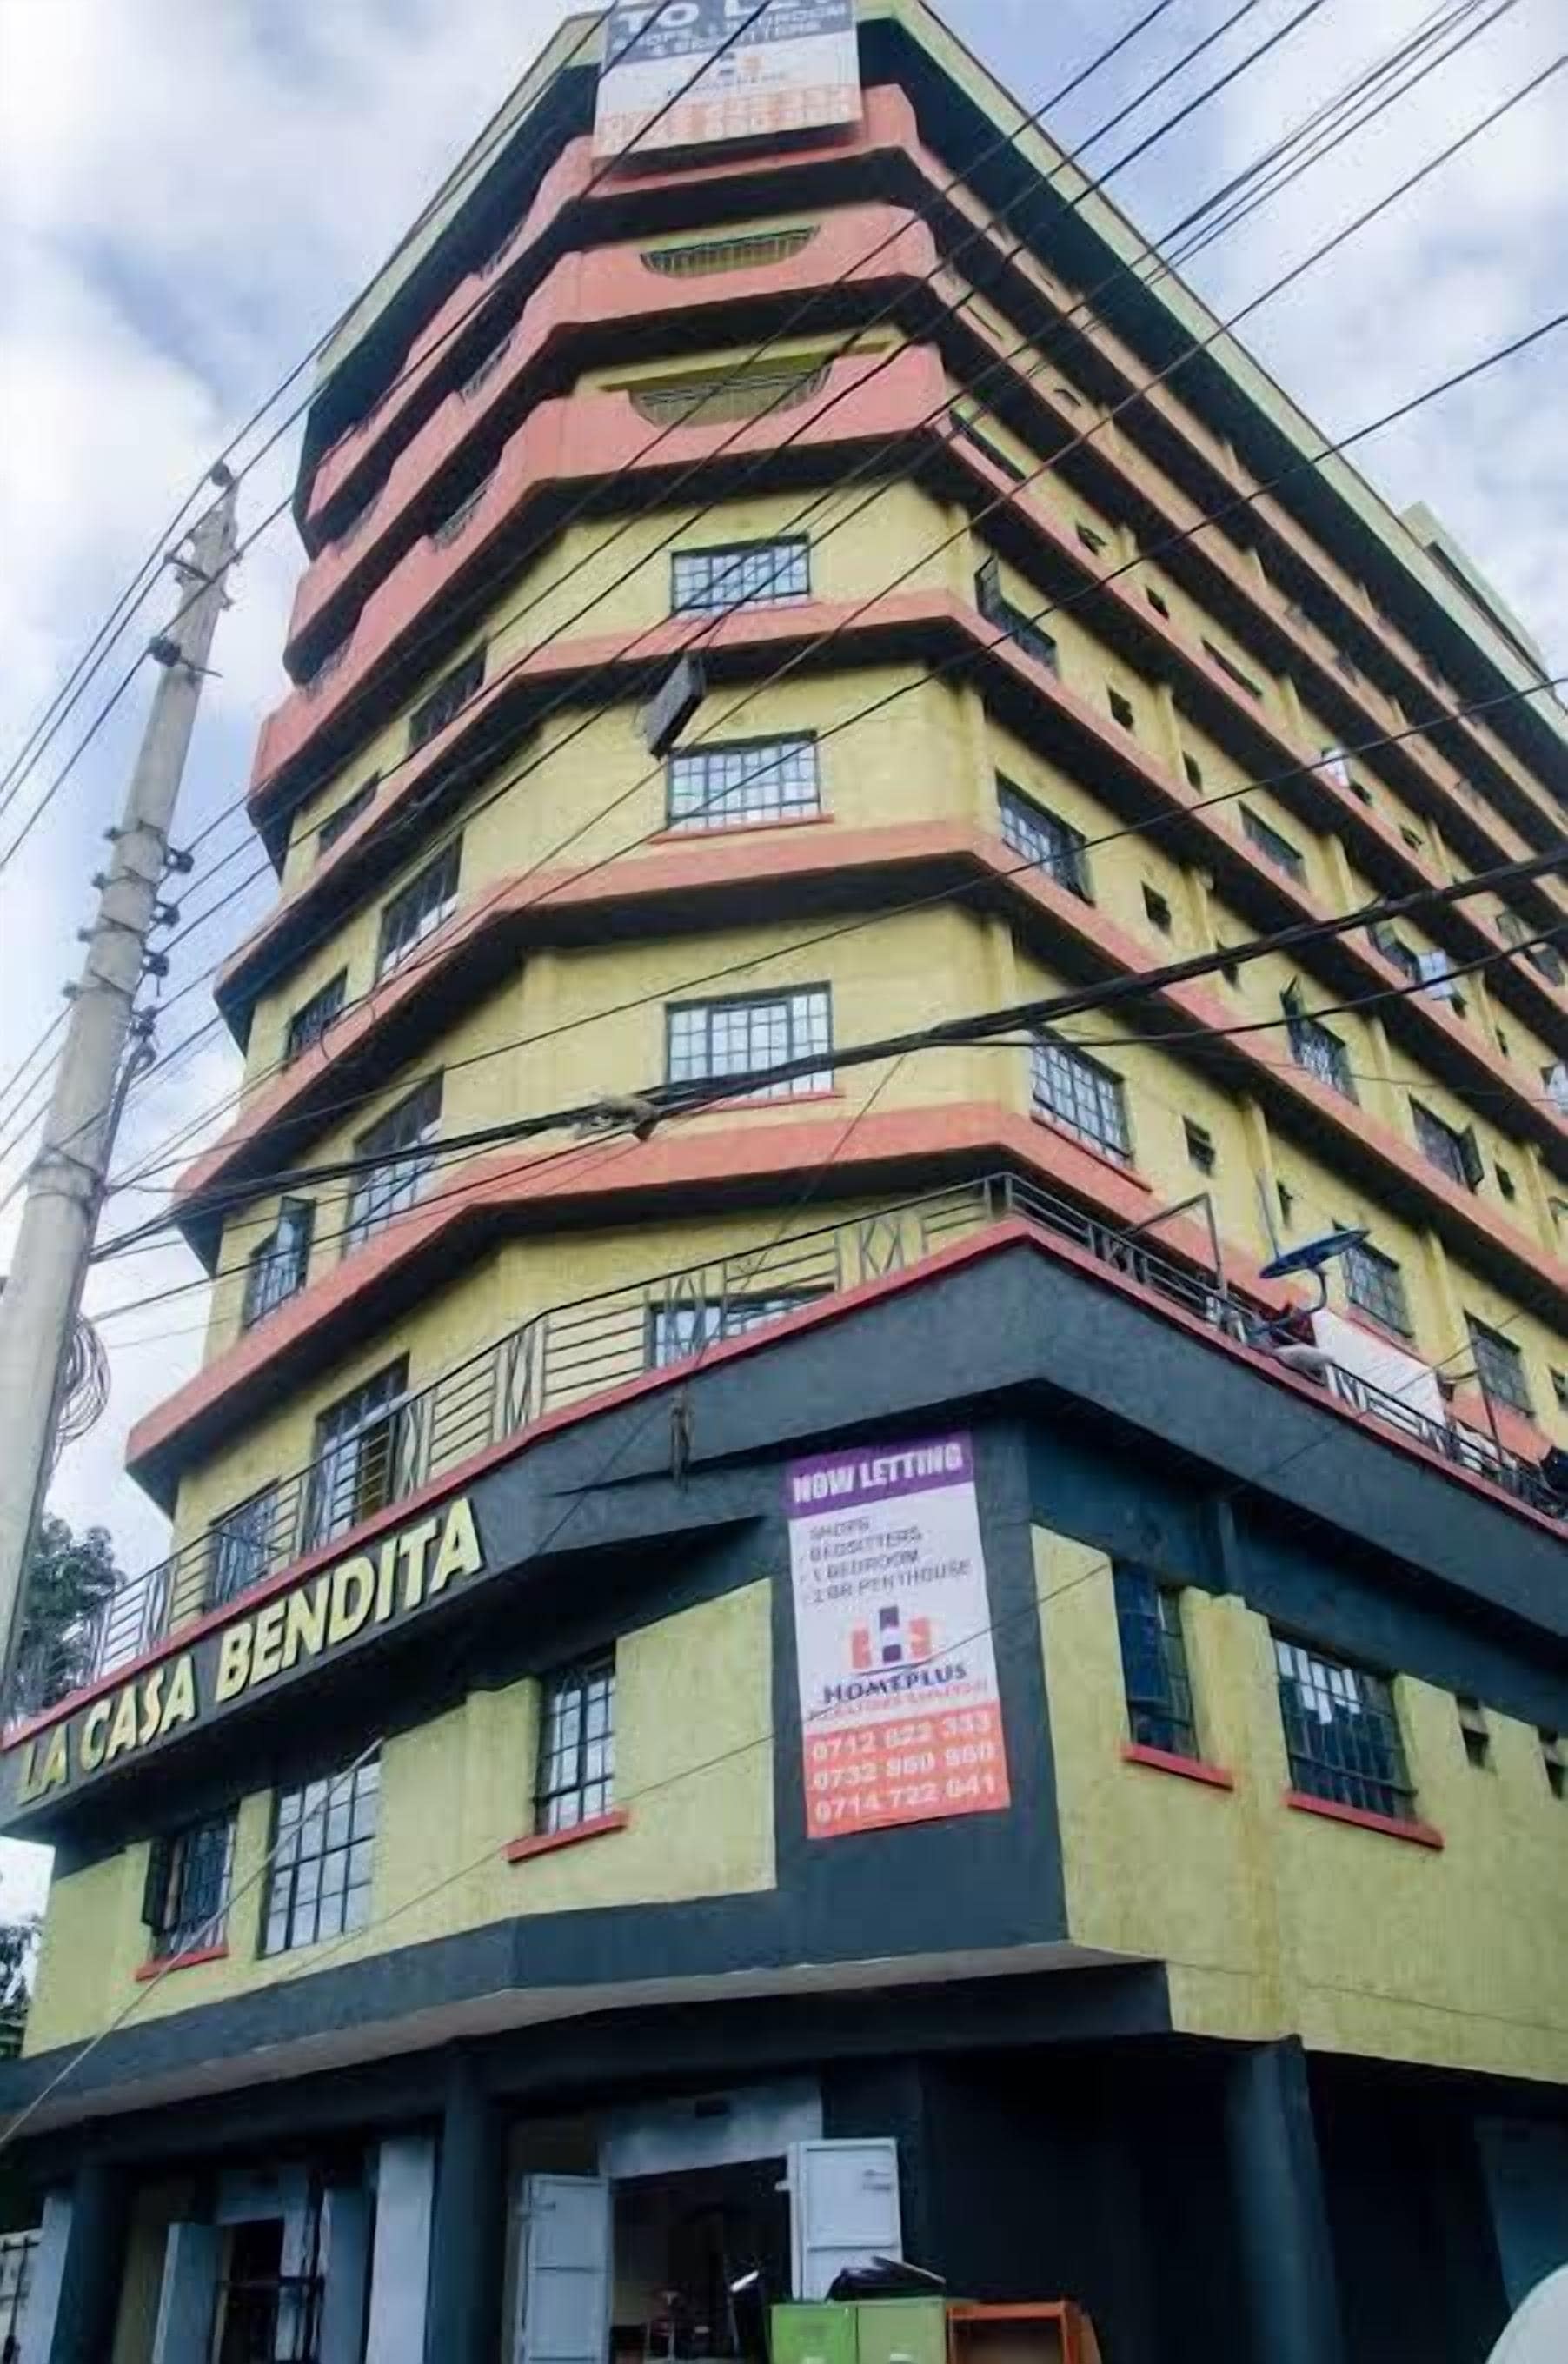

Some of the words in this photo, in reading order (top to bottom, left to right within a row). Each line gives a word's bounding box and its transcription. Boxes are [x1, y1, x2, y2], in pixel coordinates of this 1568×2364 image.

[618, 3, 699, 33] TO
[793, 1466, 855, 1504] NOW
[860, 1443, 964, 1489] LETTING
[859, 1559, 971, 1594] PENTHOUSE
[18, 1723, 68, 1805] LA
[81, 1654, 197, 1771] CASA
[215, 1497, 484, 1703] BENDITA
[824, 1665, 967, 1703] HOMEPLUS
